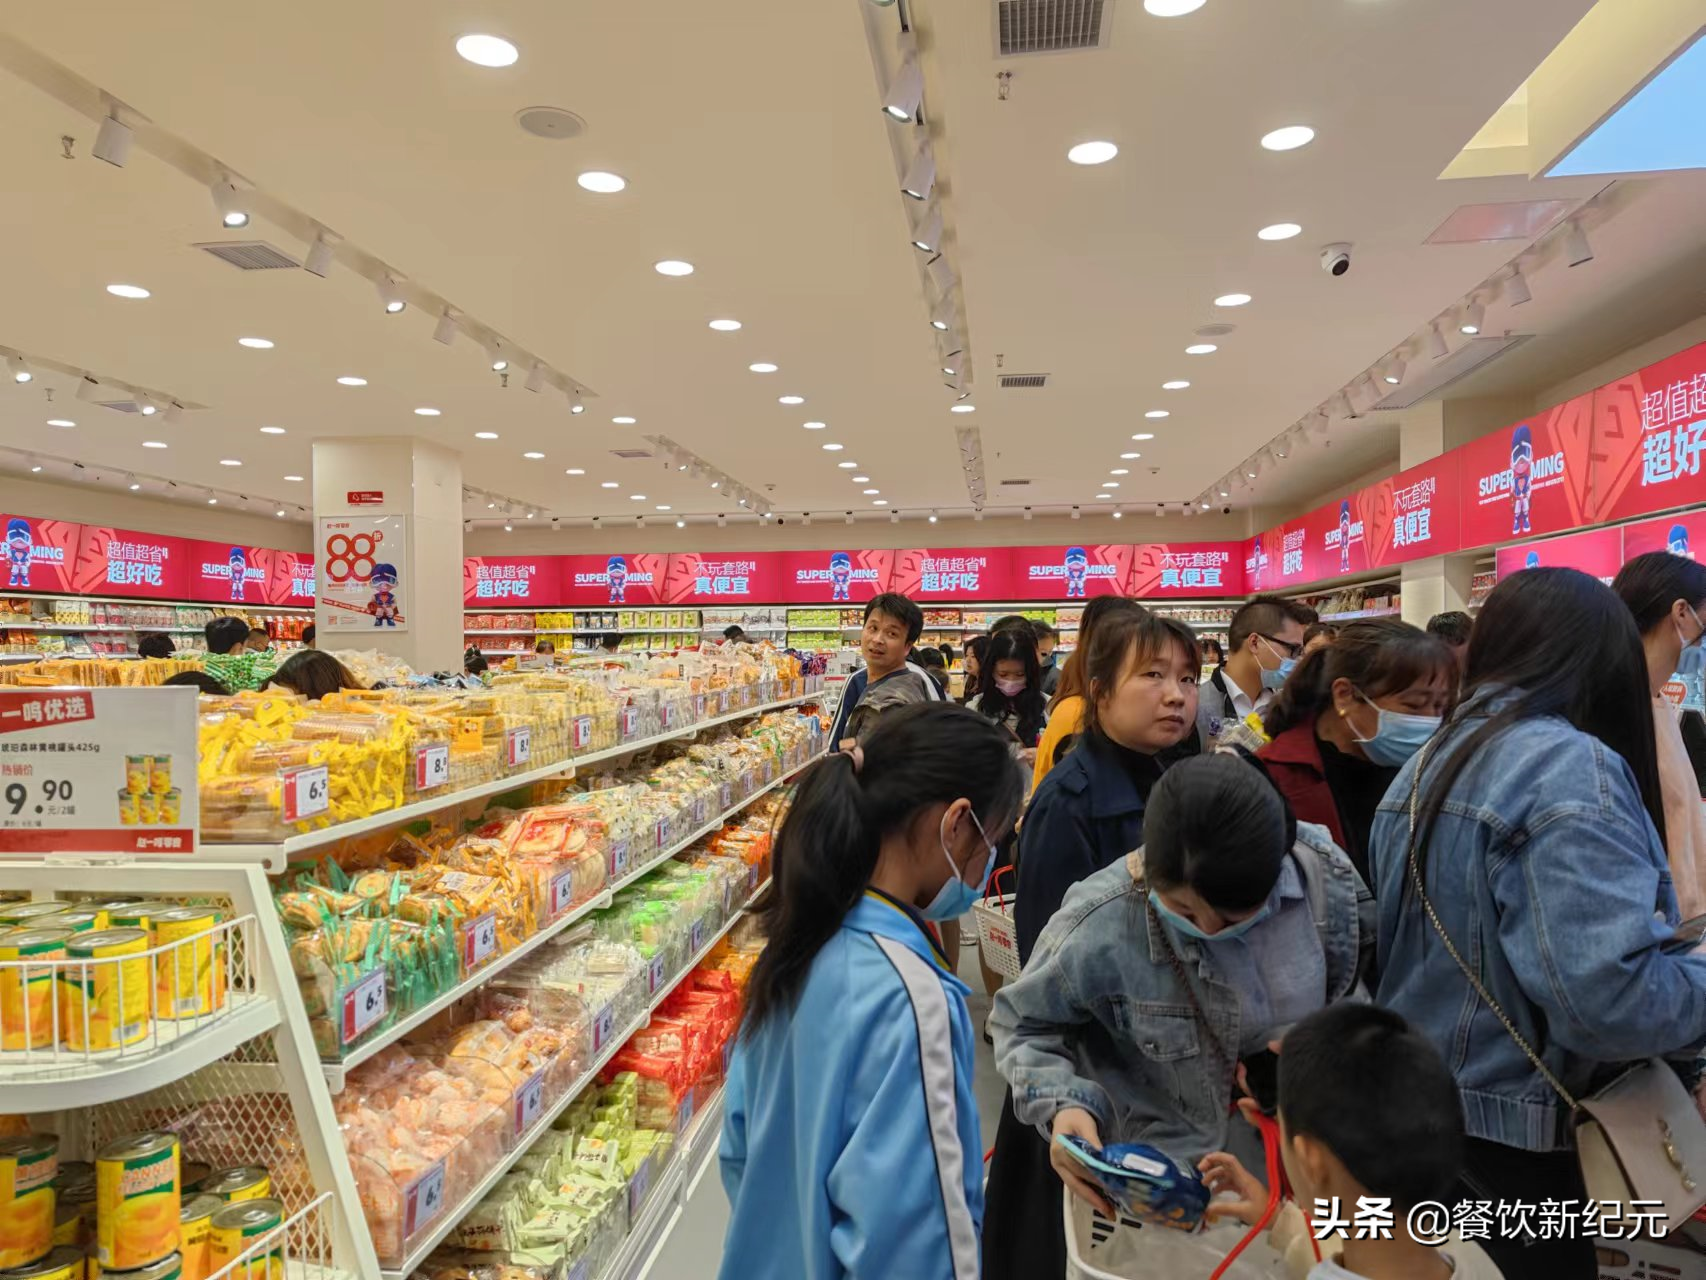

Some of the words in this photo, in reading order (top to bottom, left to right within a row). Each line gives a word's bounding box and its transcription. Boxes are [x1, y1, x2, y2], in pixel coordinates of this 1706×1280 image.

[1479, 469, 1513, 497] SUPER
[1531, 452, 1565, 479] MING
[1393, 507, 1431, 549] 真便宜
[30, 546, 64, 560] MING
[106, 541, 162, 563] 超值超省
[326, 534, 376, 582] 88
[1160, 553, 1221, 568] 不玩套路
[107, 560, 163, 586] 超好吃
[202, 563, 231, 576] SUPER
[244, 568, 265, 579] MING
[476, 566, 530, 579] 超值超省
[694, 562, 749, 576] 不玩套路
[920, 558, 980, 573] 超值超省
[1029, 565, 1067, 576] SUPER
[1085, 565, 1116, 575] MING
[575, 573, 609, 583] SUPER
[624, 573, 653, 582] MING
[797, 570, 832, 580] SUPER
[850, 569, 879, 579] MING
[920, 573, 980, 592] 超好吃
[1160, 569, 1223, 588] 真便宜
[476, 580, 530, 598] 超好吃
[695, 576, 750, 595] 真便宜
